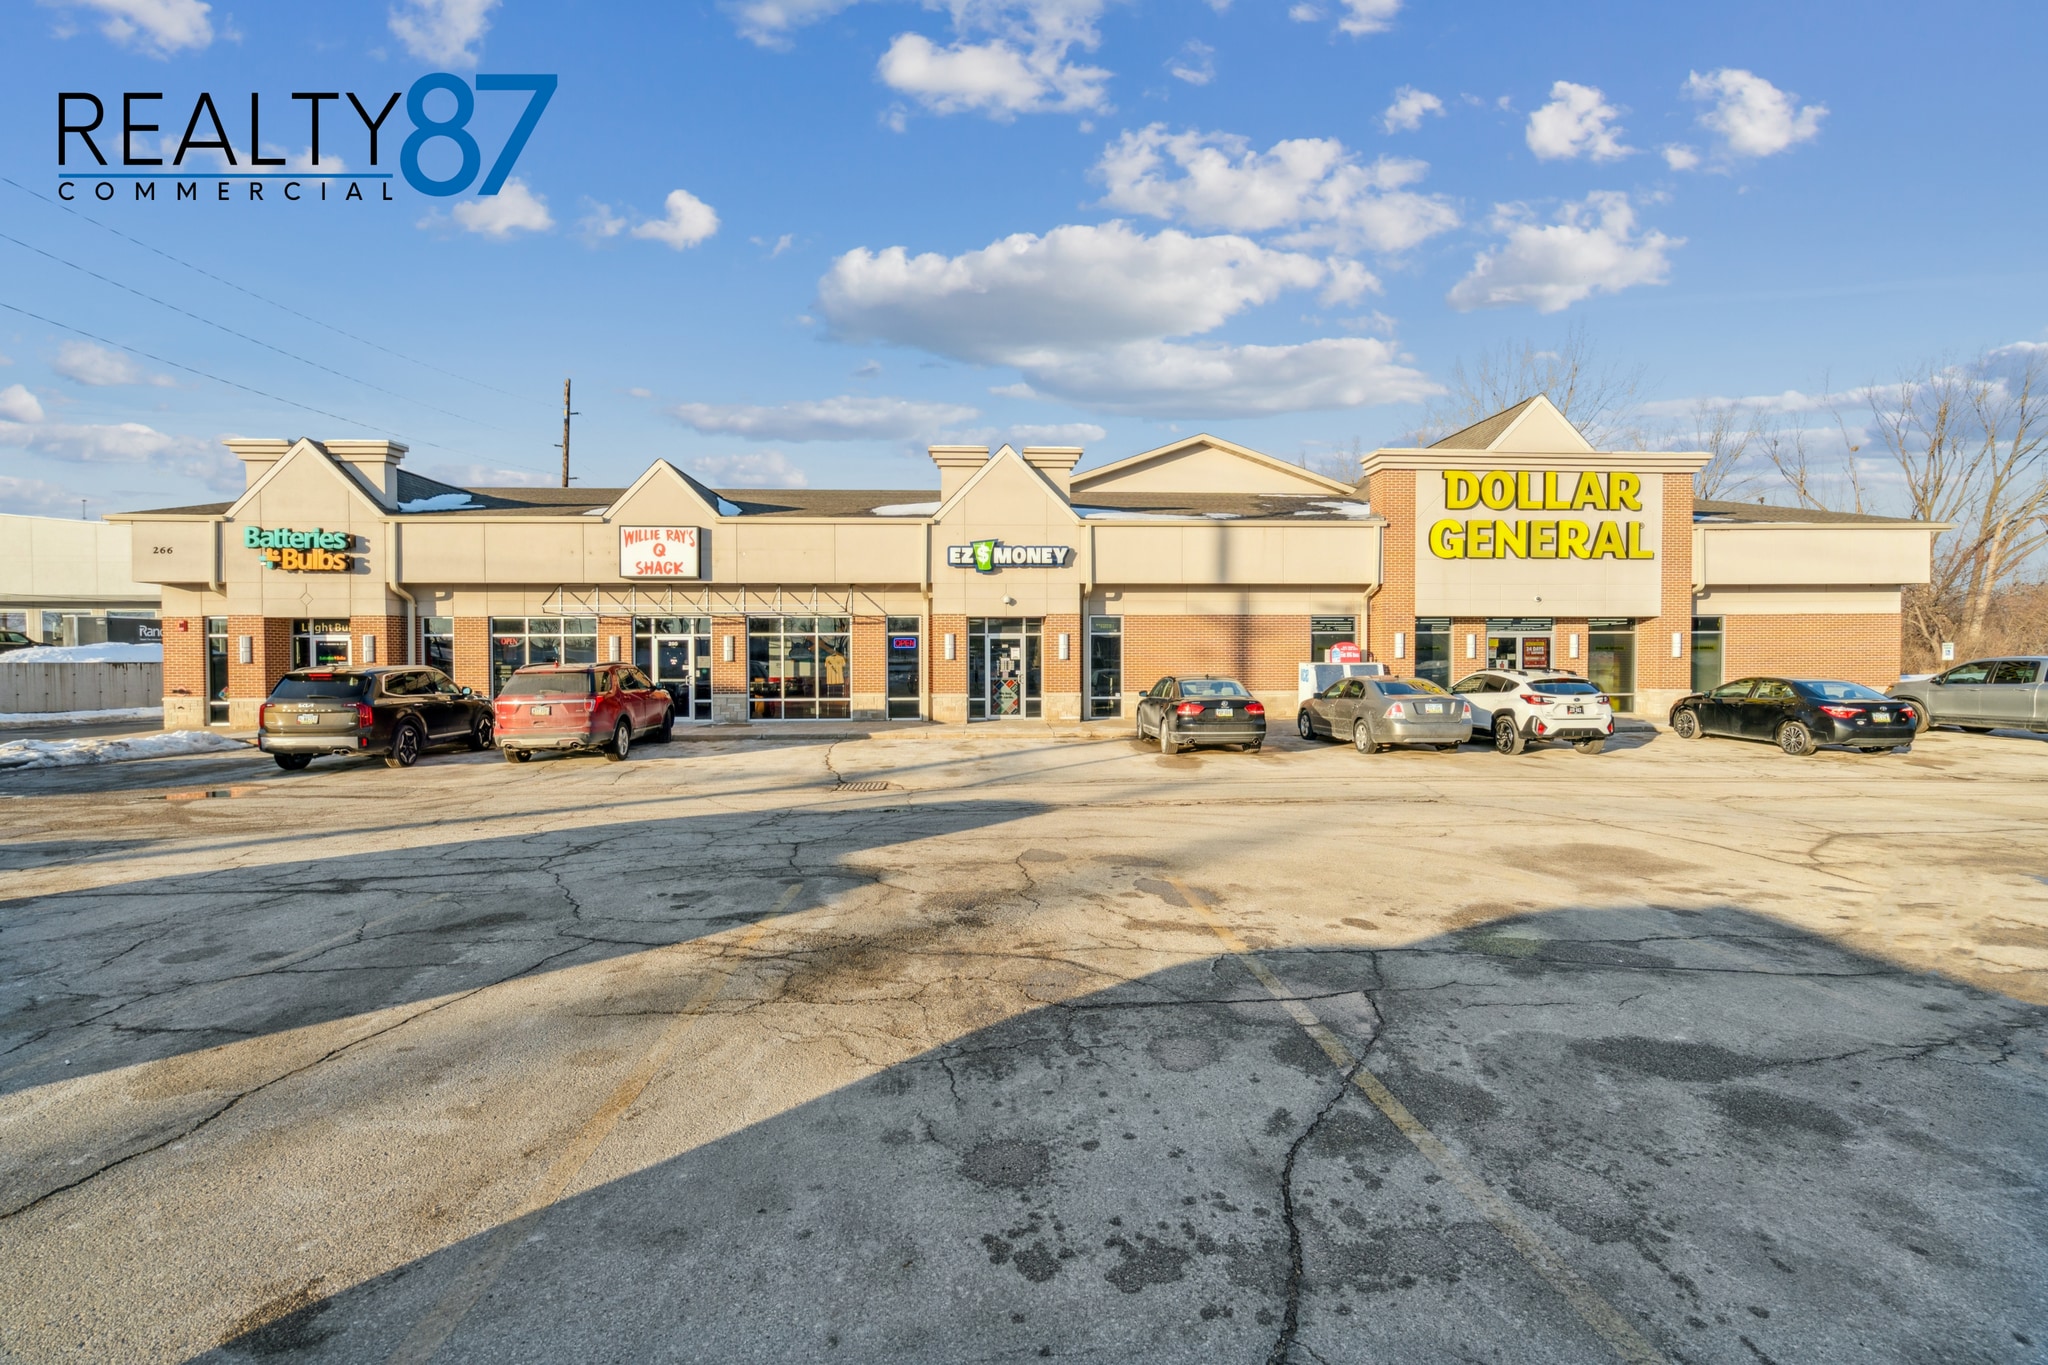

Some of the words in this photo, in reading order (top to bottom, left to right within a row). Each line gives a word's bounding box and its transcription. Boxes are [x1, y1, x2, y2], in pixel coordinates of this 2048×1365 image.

[1442, 470, 1642, 511] DOLLAR
[243, 526, 348, 550] Batteries
[623, 528, 661, 548] WILLIE
[666, 528, 696, 548] RAY'S
[1429, 518, 1654, 560] GENERAL
[152, 546, 174, 555] 266
[653, 542, 666, 558] Q
[635, 560, 684, 575] SHACK
[500, 637, 518, 646] OPEN
